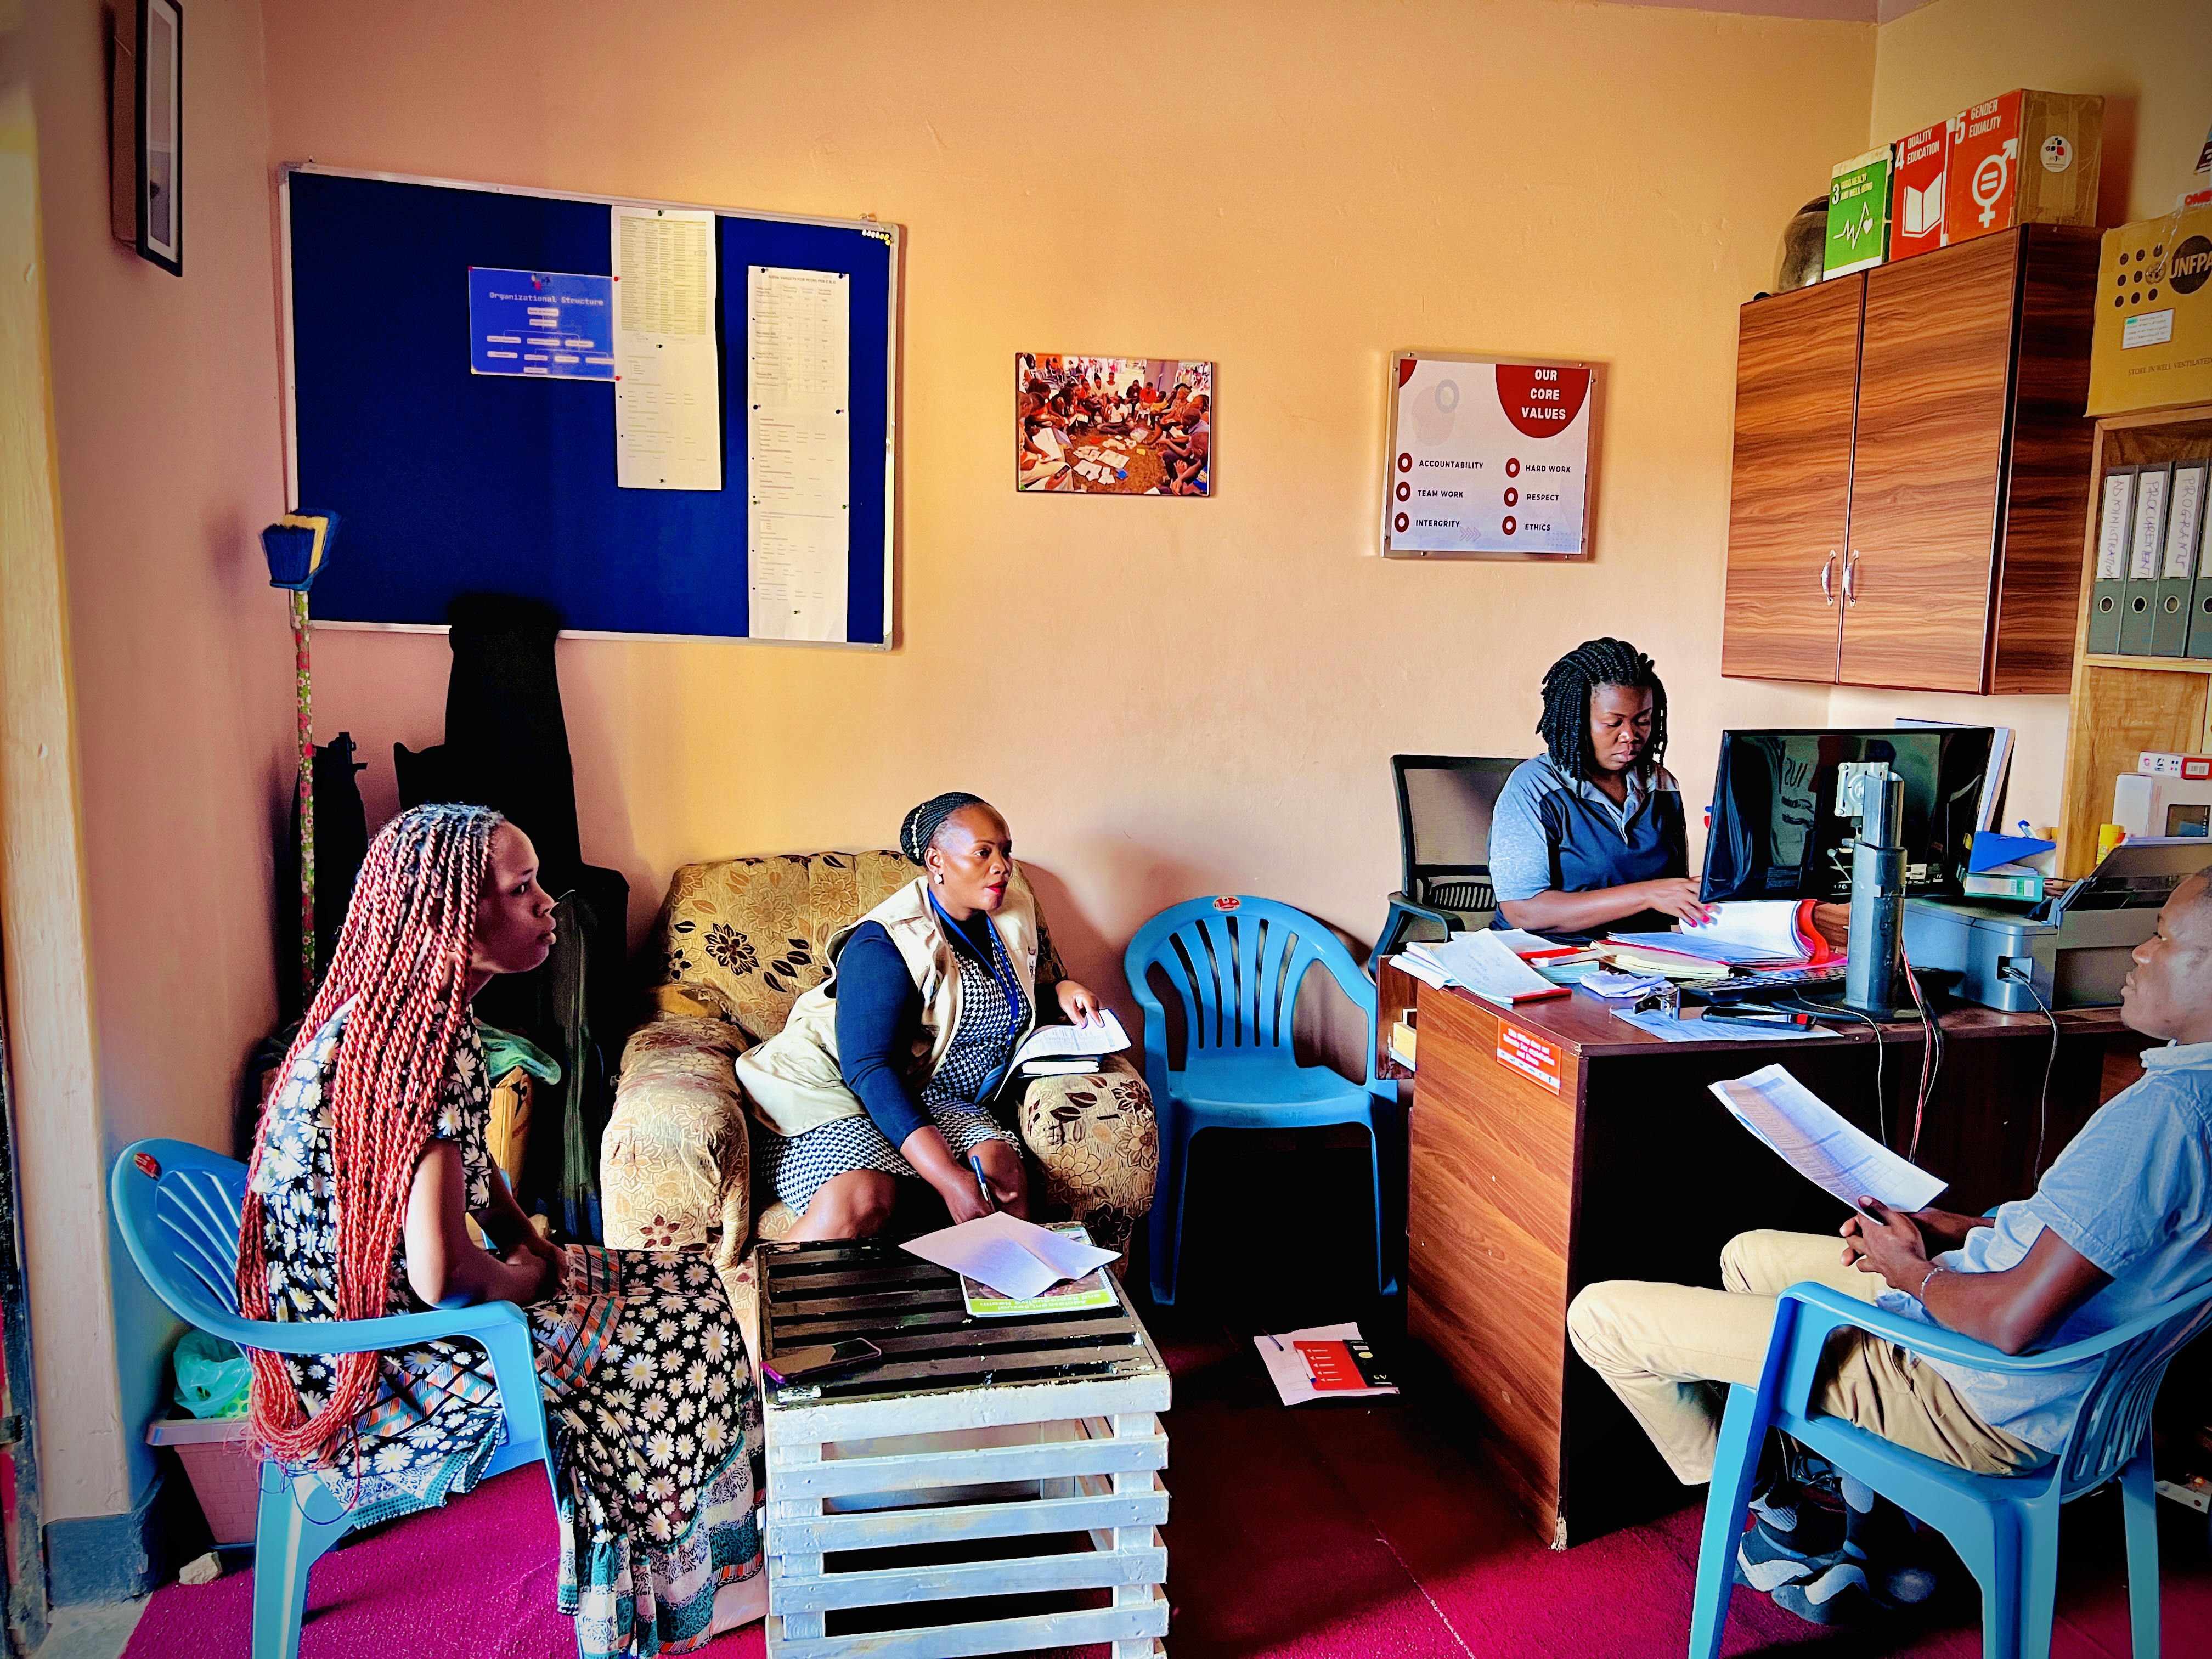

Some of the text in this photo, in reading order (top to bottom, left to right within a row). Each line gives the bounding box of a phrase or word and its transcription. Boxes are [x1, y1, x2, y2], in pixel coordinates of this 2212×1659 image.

[1971, 99, 1999, 120] GENDER
[1955, 111, 1967, 144] 5
[1968, 115, 2002, 138] EQUALITY
[1908, 128, 1933, 149] QUALITY
[1895, 141, 1904, 170] 4
[1906, 140, 1939, 165] EDUCATION
[1832, 184, 1840, 205] 3
[2169, 251, 2212, 279] UNFPA
[489, 292, 603, 306] Organizational Structure
[1534, 369, 1558, 381] OUR
[1530, 388, 1560, 400] CORE
[1521, 407, 1566, 420] VALUES
[1419, 460, 1483, 469] ACCOUNTABILITY
